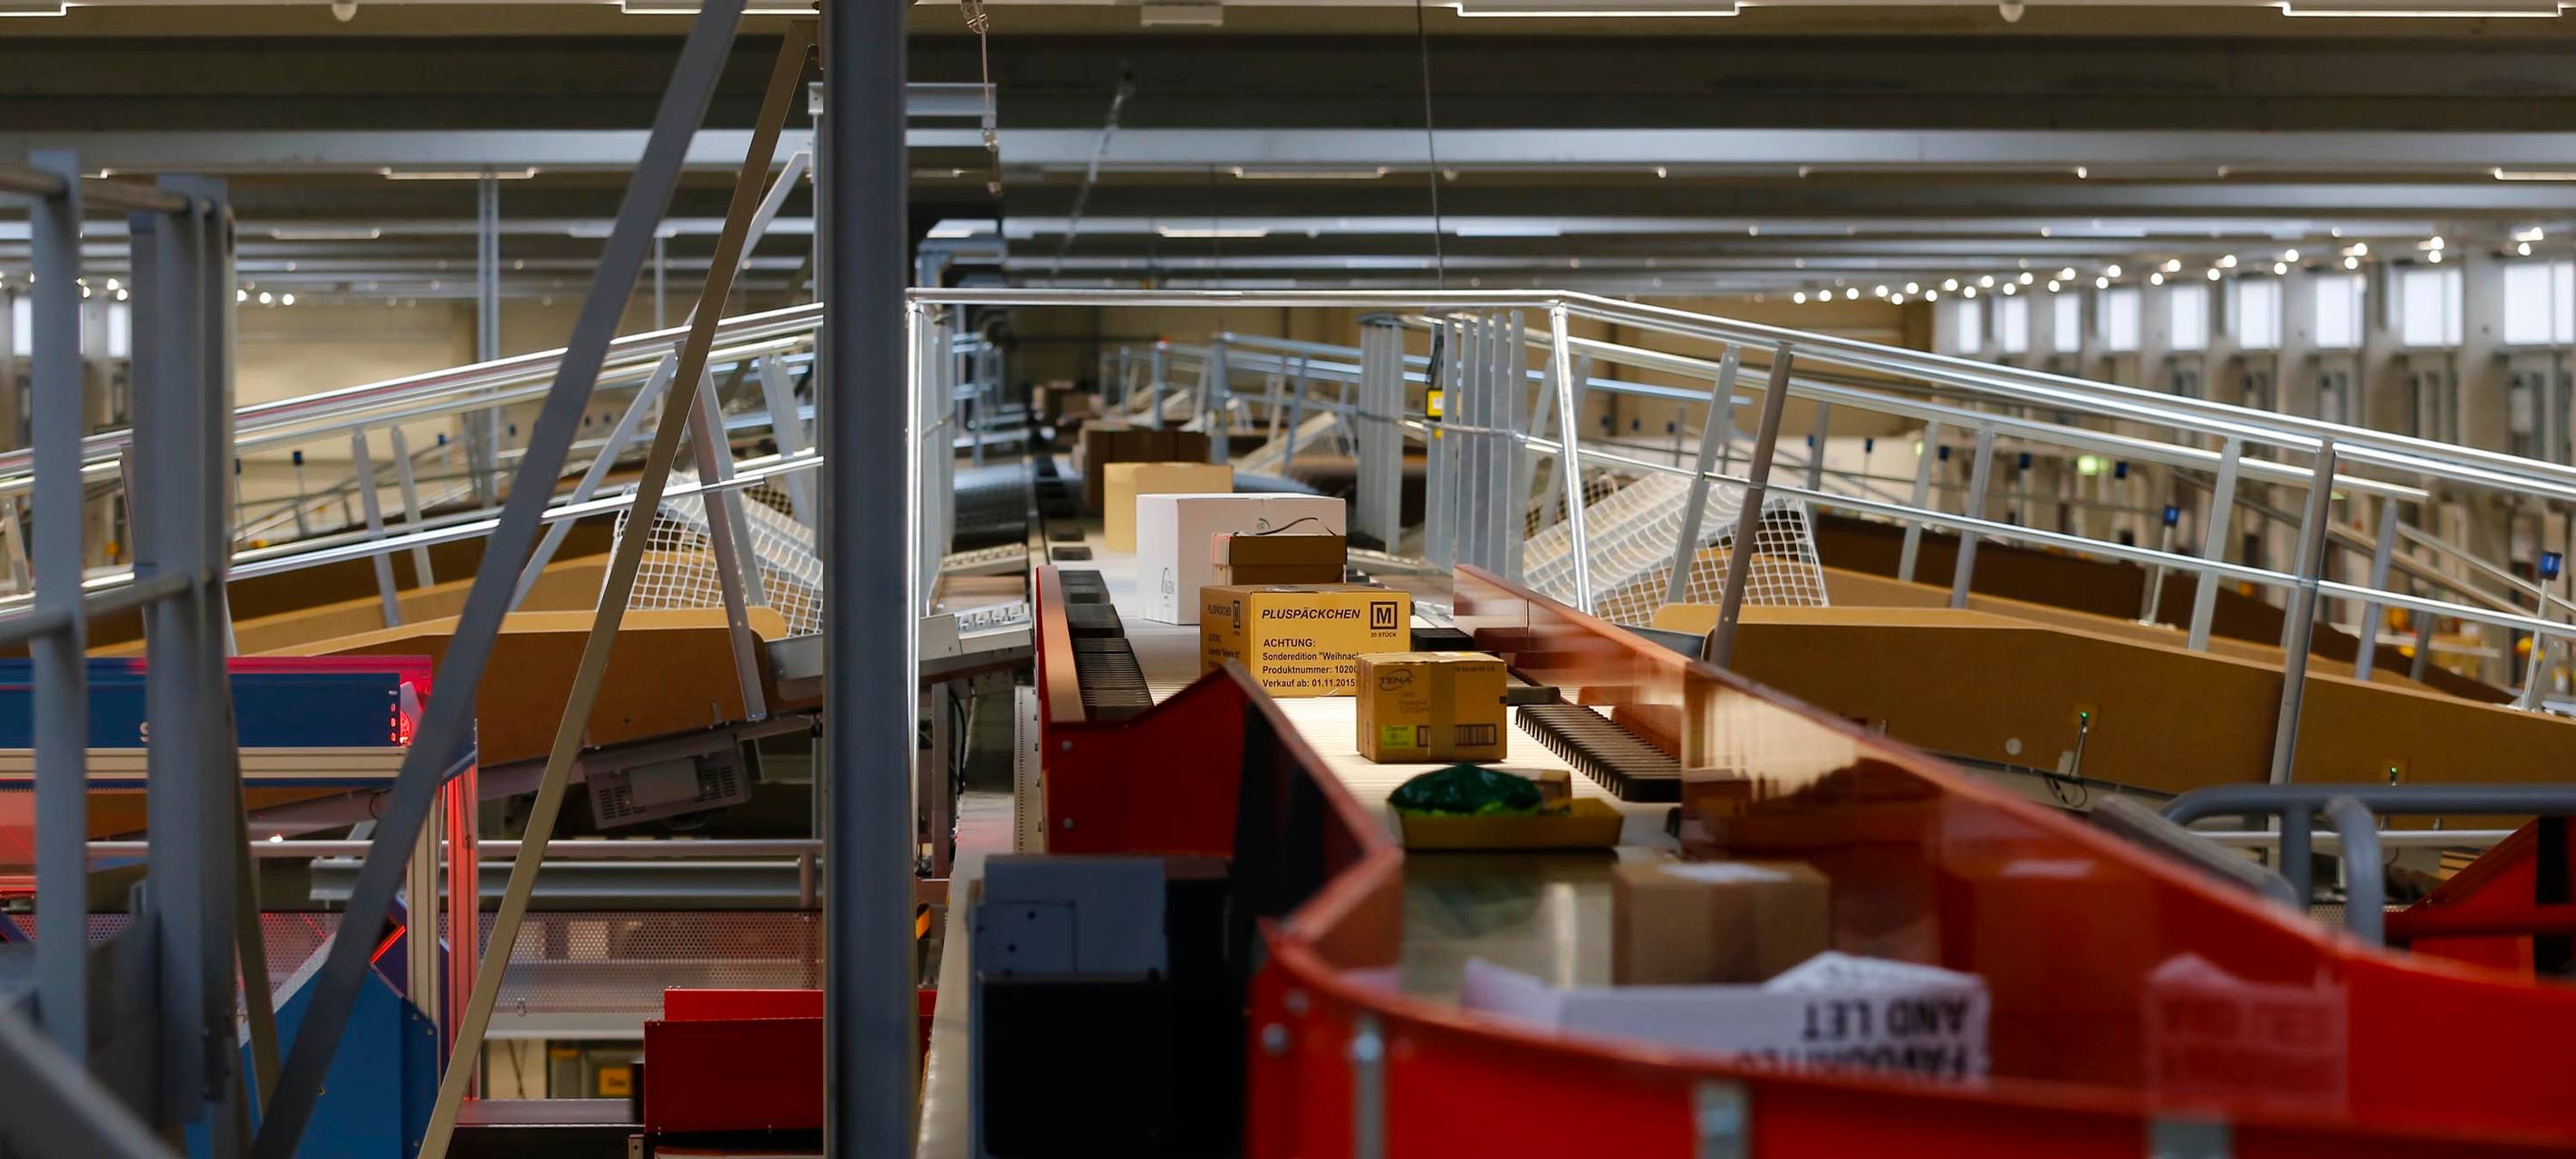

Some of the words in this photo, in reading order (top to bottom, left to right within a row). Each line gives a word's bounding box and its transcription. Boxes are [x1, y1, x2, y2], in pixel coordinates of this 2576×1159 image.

[1262, 607, 1360, 619] PLUSPÄCKCHEN
[1376, 608, 1392, 624] M
[1263, 638, 1316, 647] ACHTUNG:
[1263, 652, 1317, 660] Sonderedition
[1262, 666, 1332, 674] Produktnummer:
[1263, 679, 1295, 687] Verkauf
[1296, 679, 1310, 687] ab:
[1312, 679, 1356, 687] 01.11.2015
[1803, 1000, 1872, 1040] LET
[1884, 998, 1967, 1037] AND
